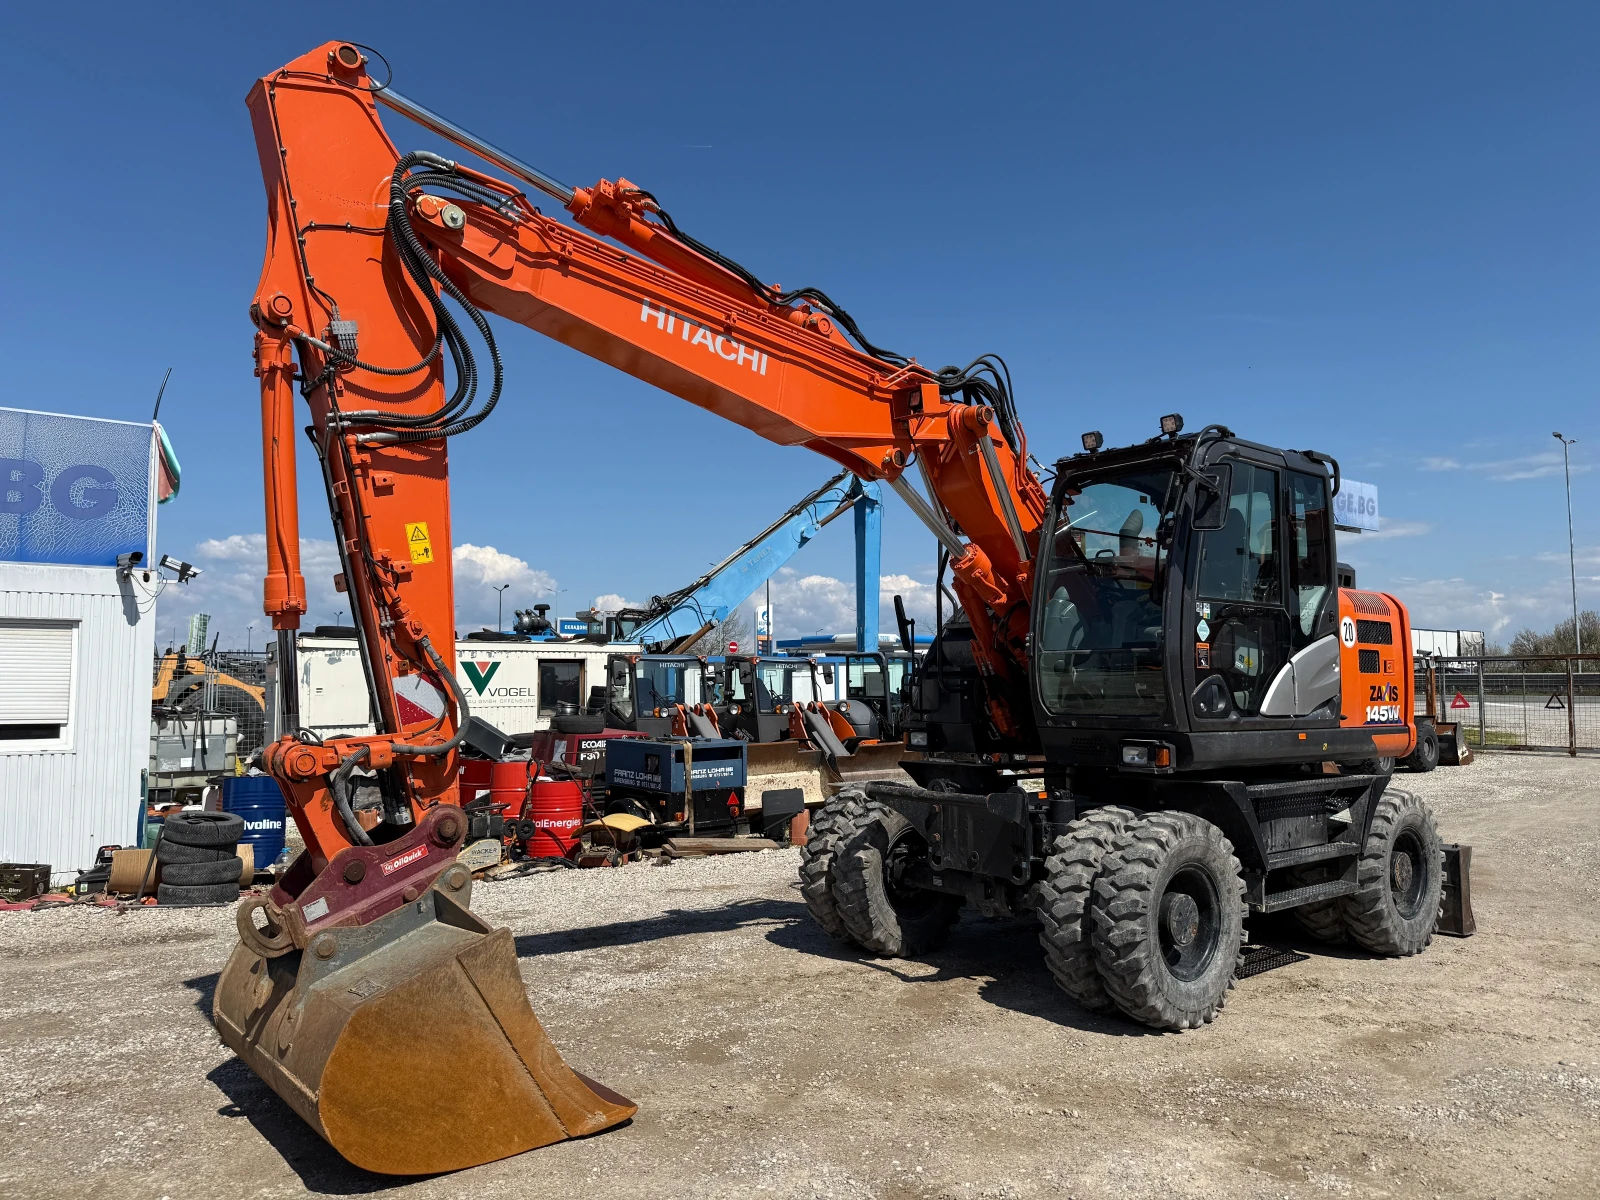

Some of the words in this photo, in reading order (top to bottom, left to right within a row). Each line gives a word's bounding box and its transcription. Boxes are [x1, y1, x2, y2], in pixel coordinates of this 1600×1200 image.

[640, 298, 768, 376] HITACHI
[1335, 491, 1376, 517] GE.BG
[1343, 622, 1354, 642] 20
[488, 687, 536, 697] VOGEL
[1369, 682, 1399, 702] ZAXIS
[1365, 704, 1401, 722] 145W
[613, 768, 635, 779] FRANZ
[635, 771, 653, 782] LOHR
[707, 766, 725, 774] LOHR
[393, 849, 423, 868] OilQuick
[471, 847, 498, 856] WACKER
